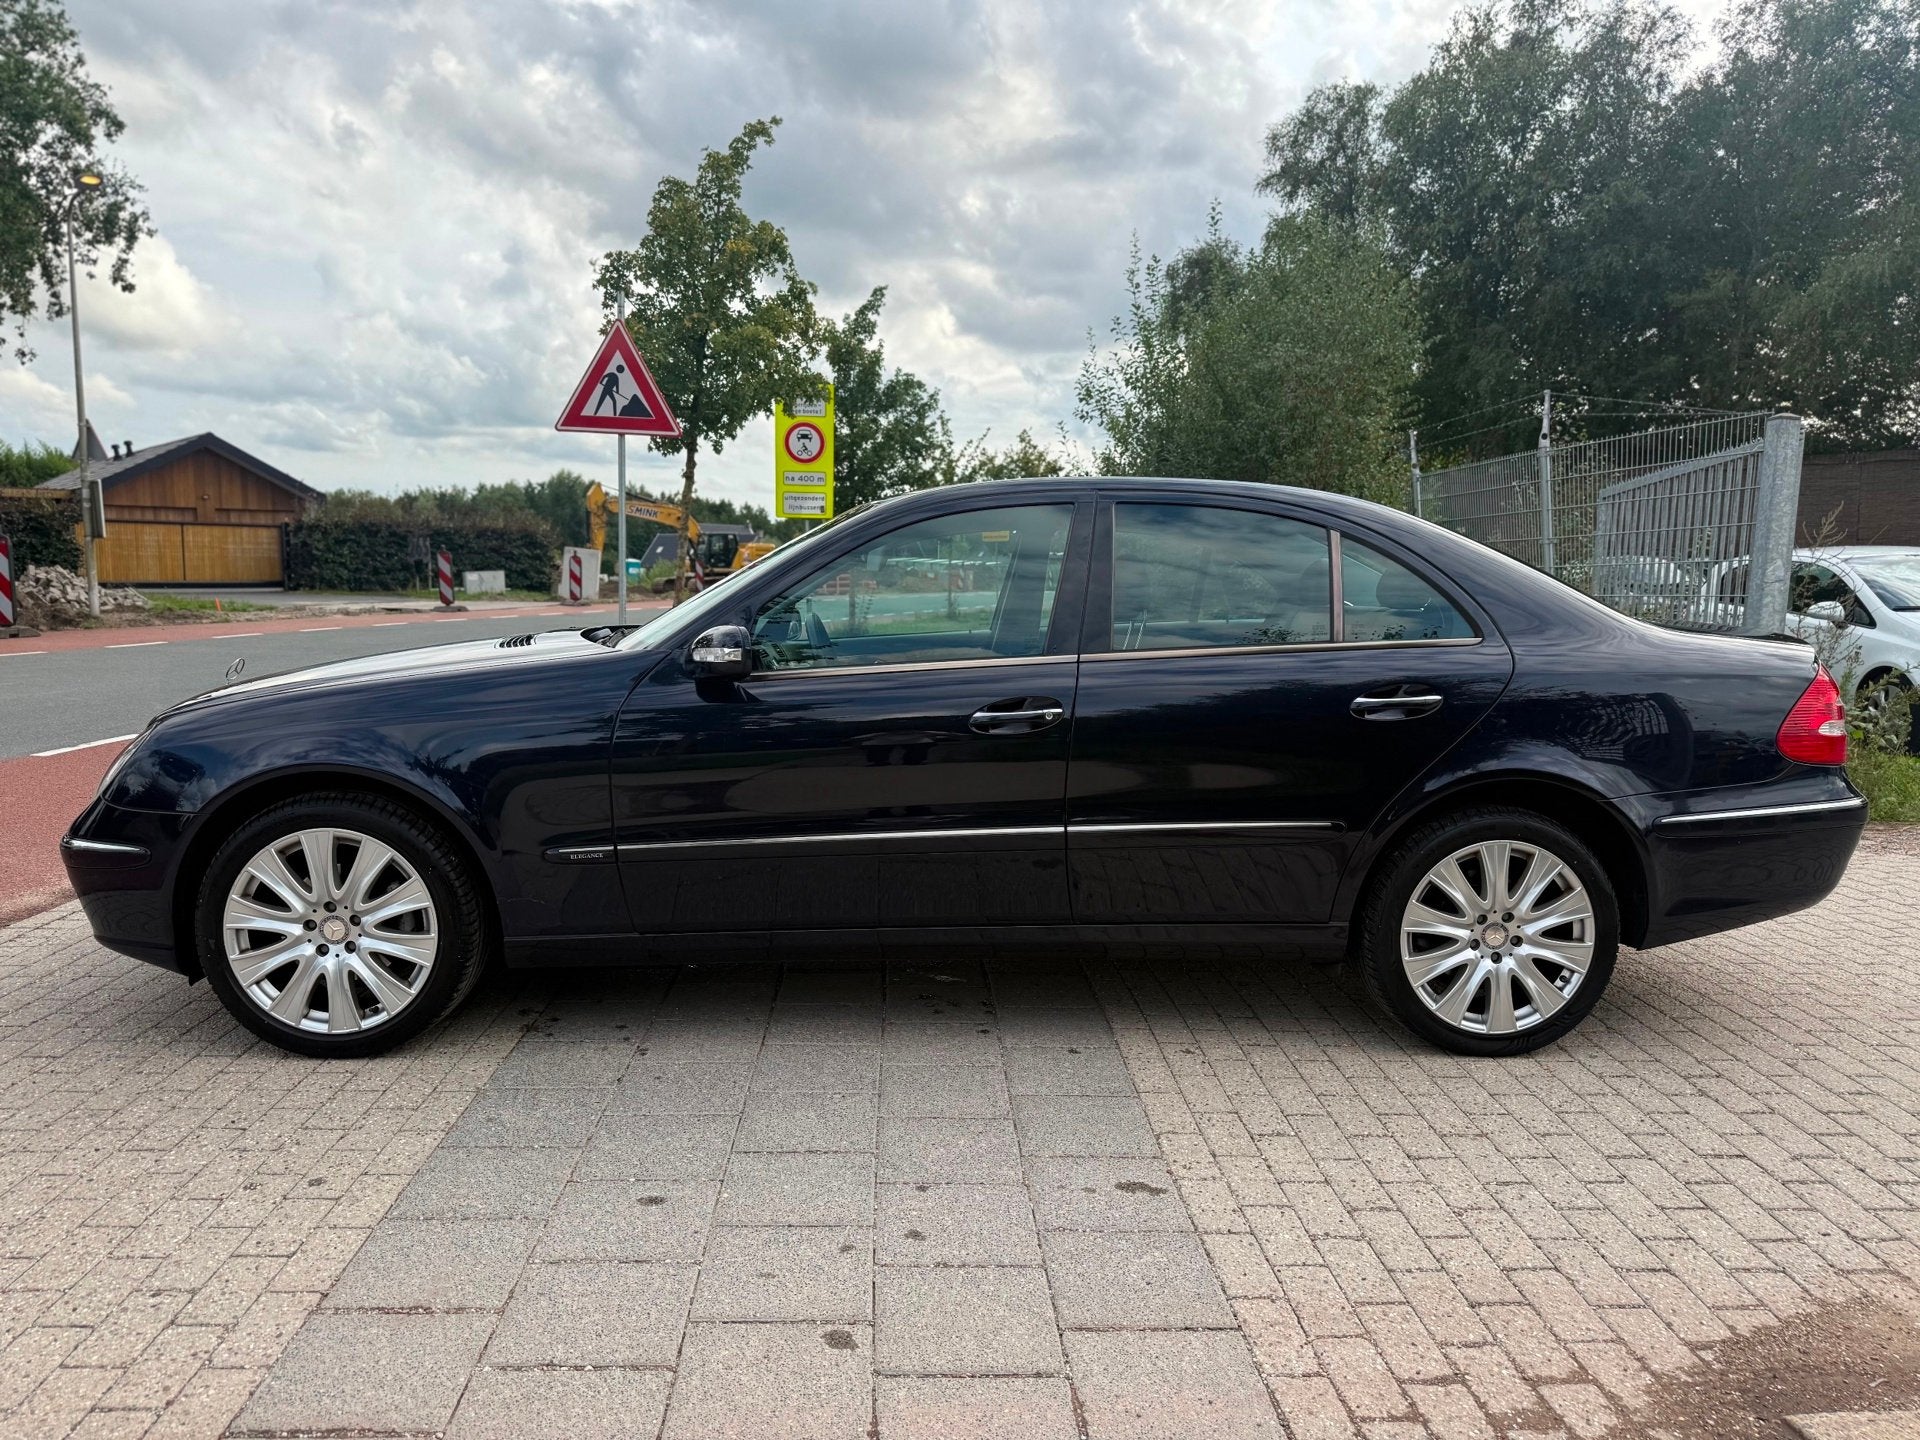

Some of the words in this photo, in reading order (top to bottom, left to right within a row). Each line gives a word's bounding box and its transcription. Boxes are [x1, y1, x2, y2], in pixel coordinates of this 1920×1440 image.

[784, 495, 825, 503] uitgezonderd
[626, 504, 658, 519] SMINK
[570, 852, 604, 860] ELEGANCE
